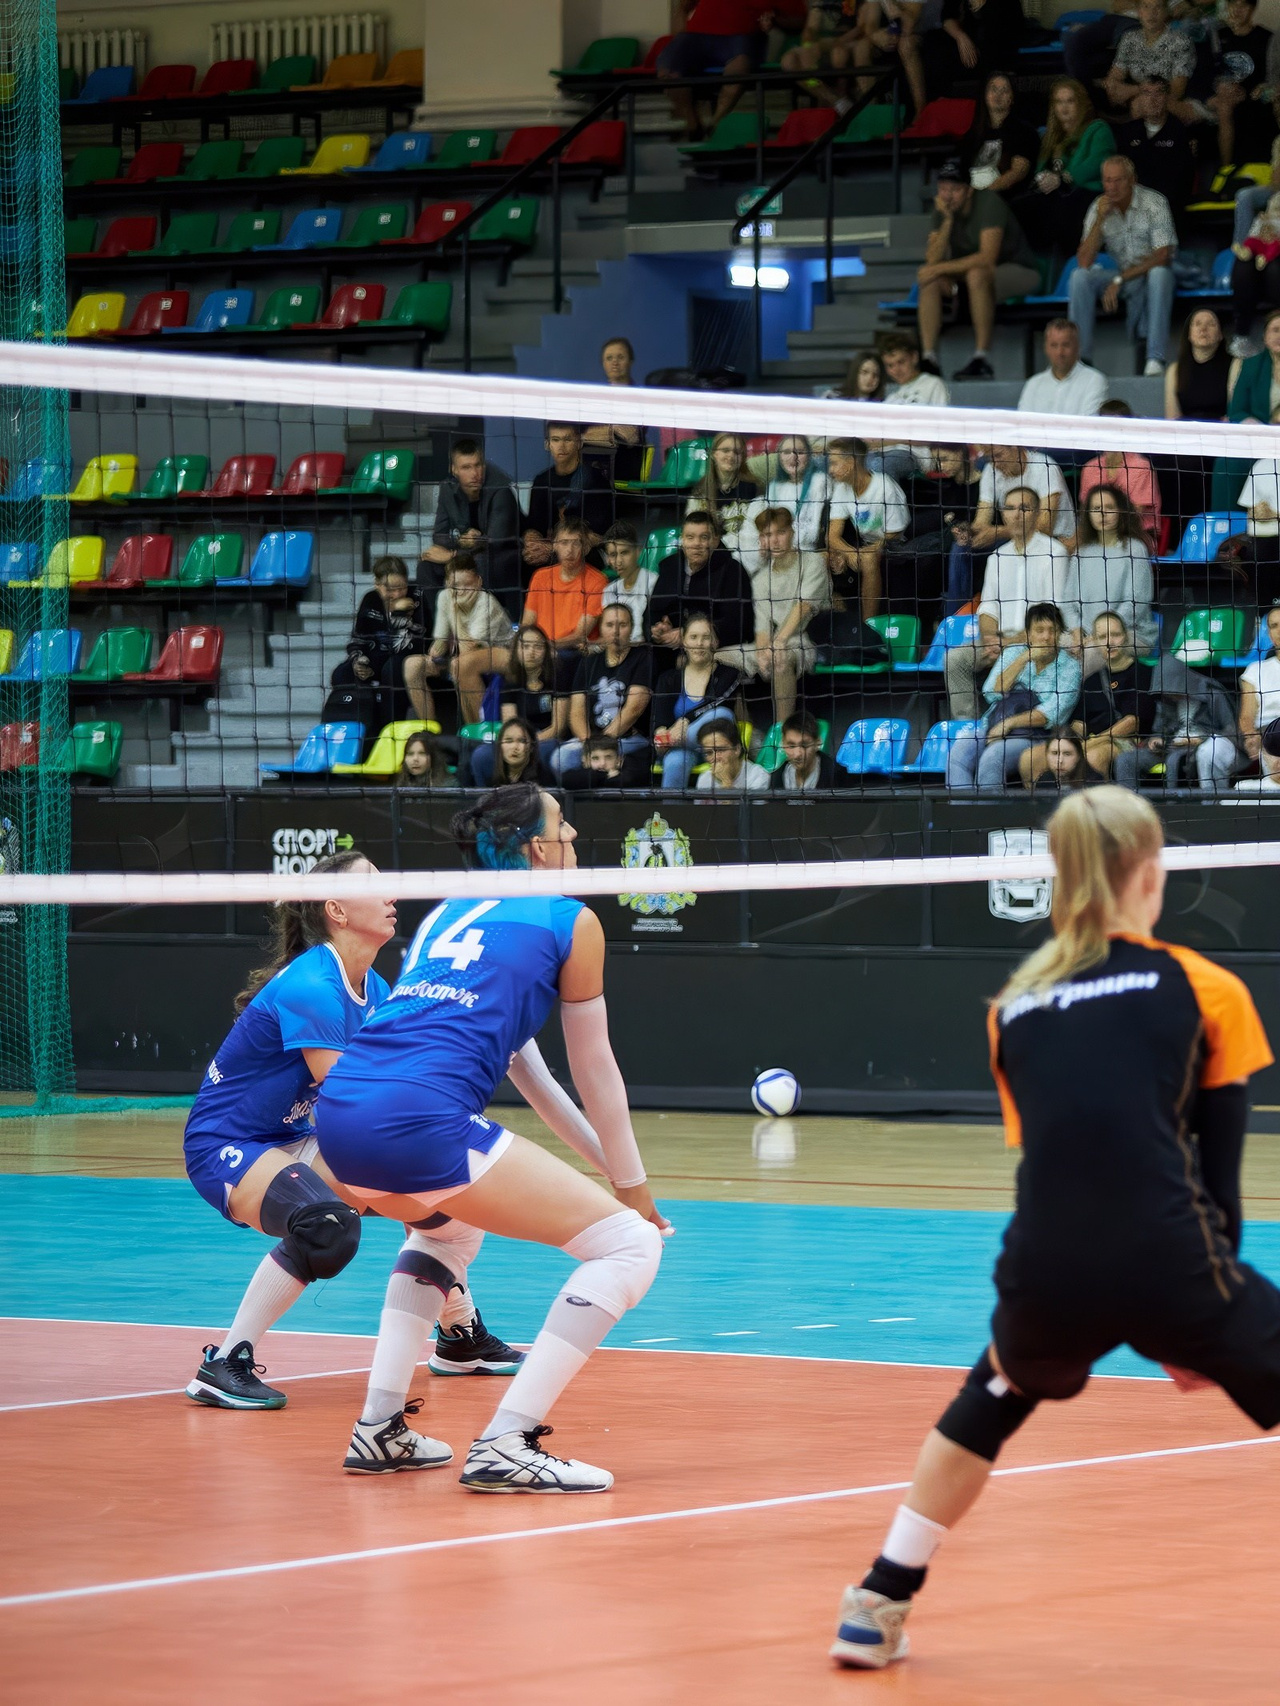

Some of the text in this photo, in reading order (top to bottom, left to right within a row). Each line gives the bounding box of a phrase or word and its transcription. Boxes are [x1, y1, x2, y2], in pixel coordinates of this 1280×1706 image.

[272, 828, 339, 855] СПОРТ
[273, 855, 331, 875] НОР
[404, 899, 502, 971] 14
[219, 1145, 244, 1168] 3
